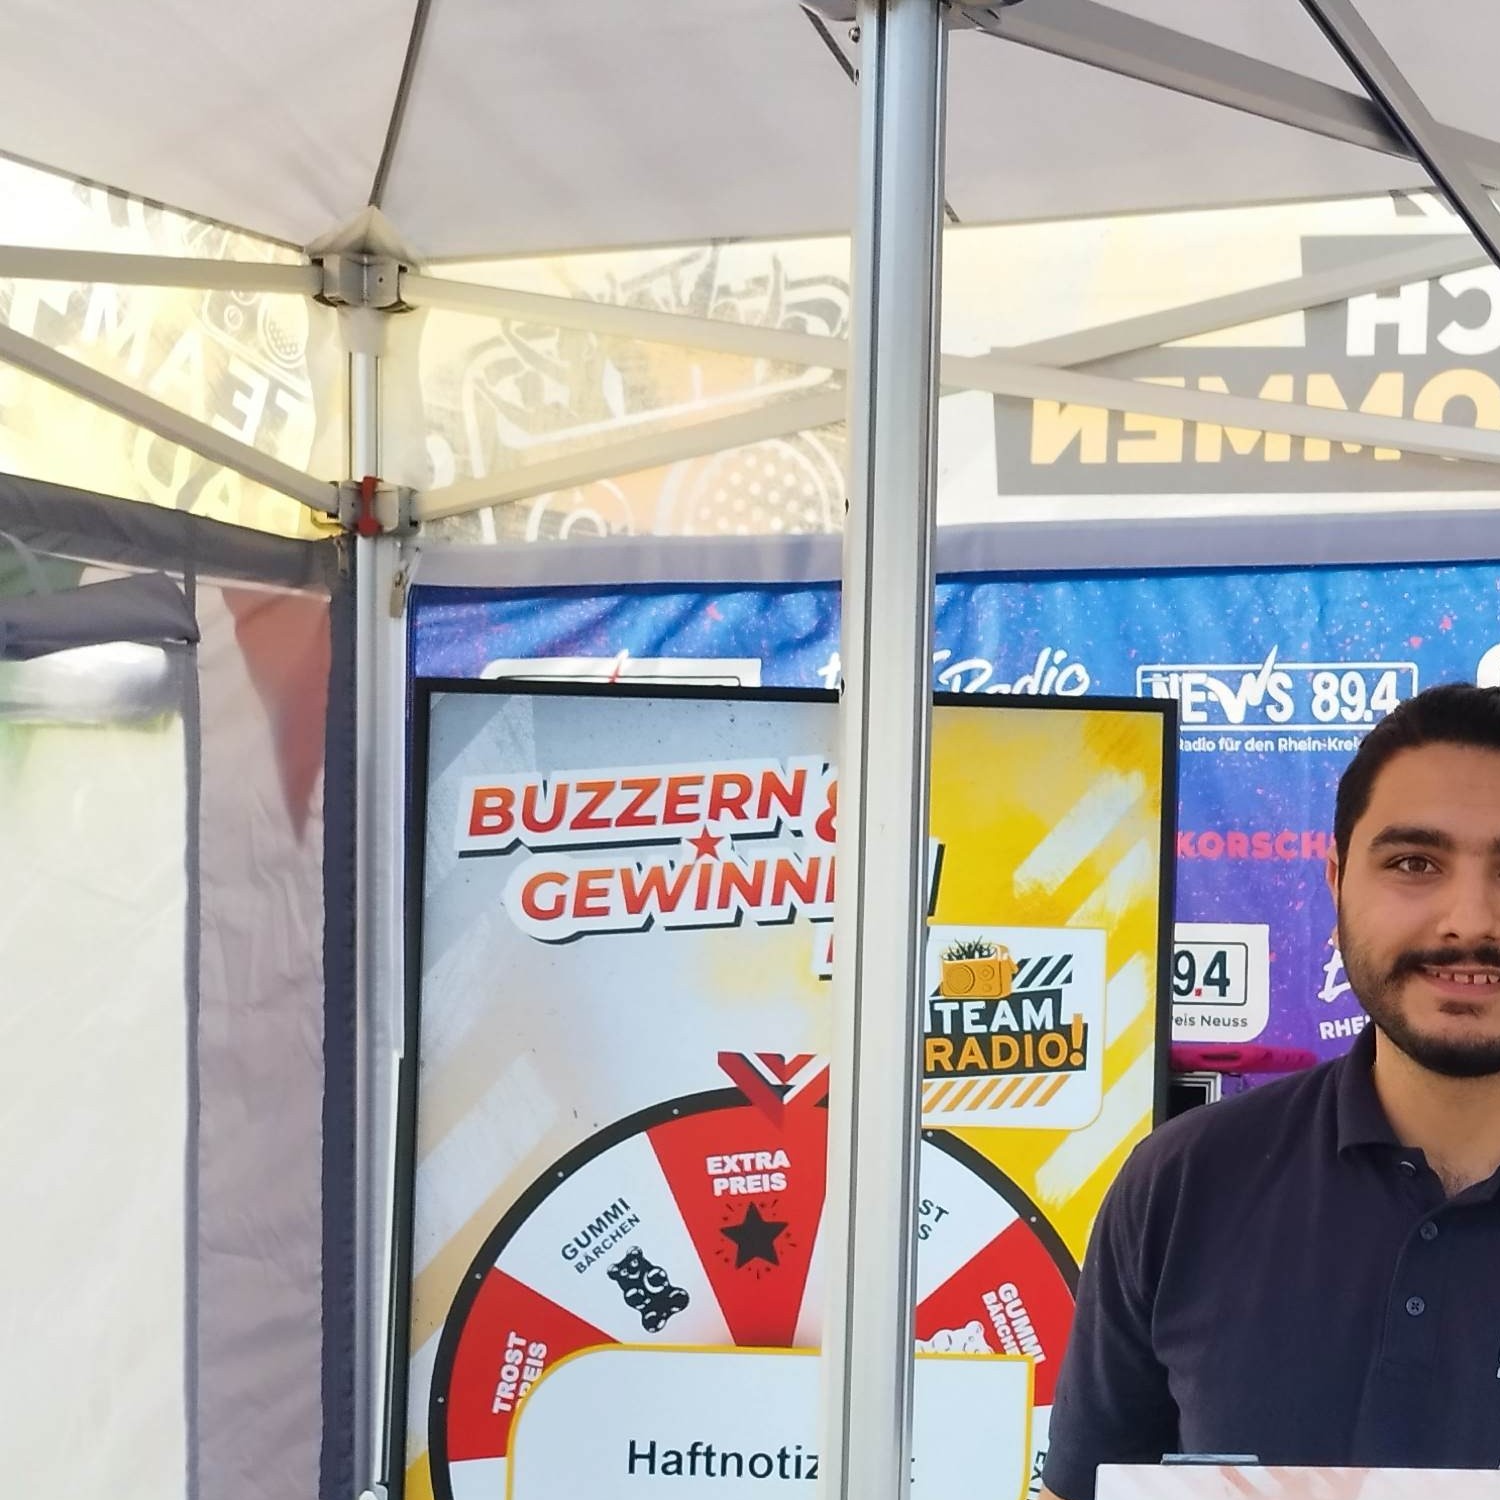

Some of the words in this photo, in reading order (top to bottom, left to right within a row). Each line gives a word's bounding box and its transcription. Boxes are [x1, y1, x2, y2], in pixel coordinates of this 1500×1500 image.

[1310, 670, 1400, 723] 89.4
[1218, 736, 1242, 752] für
[1245, 736, 1271, 753] den
[1277, 736, 1359, 753] Rhein-Krei
[467, 768, 807, 838] BUZZERN
[1177, 830, 1327, 860] KORSCH
[520, 855, 836, 922] GEWINN
[1173, 949, 1232, 999] 9.4
[924, 1012, 1084, 1073] RADIO!
[932, 997, 1055, 1035] TEAM
[1200, 1013, 1248, 1029] Neuss
[705, 1149, 791, 1176] EXTRA
[713, 1172, 788, 1197] PREIS
[561, 1197, 632, 1262] GUMMI
[574, 1213, 641, 1275] BÄRCHEN
[998, 1282, 1047, 1364] GUMMI
[492, 1331, 527, 1414] TROST
[516, 1342, 548, 1409] REIS
[627, 1439, 819, 1481] Haftnotiz
